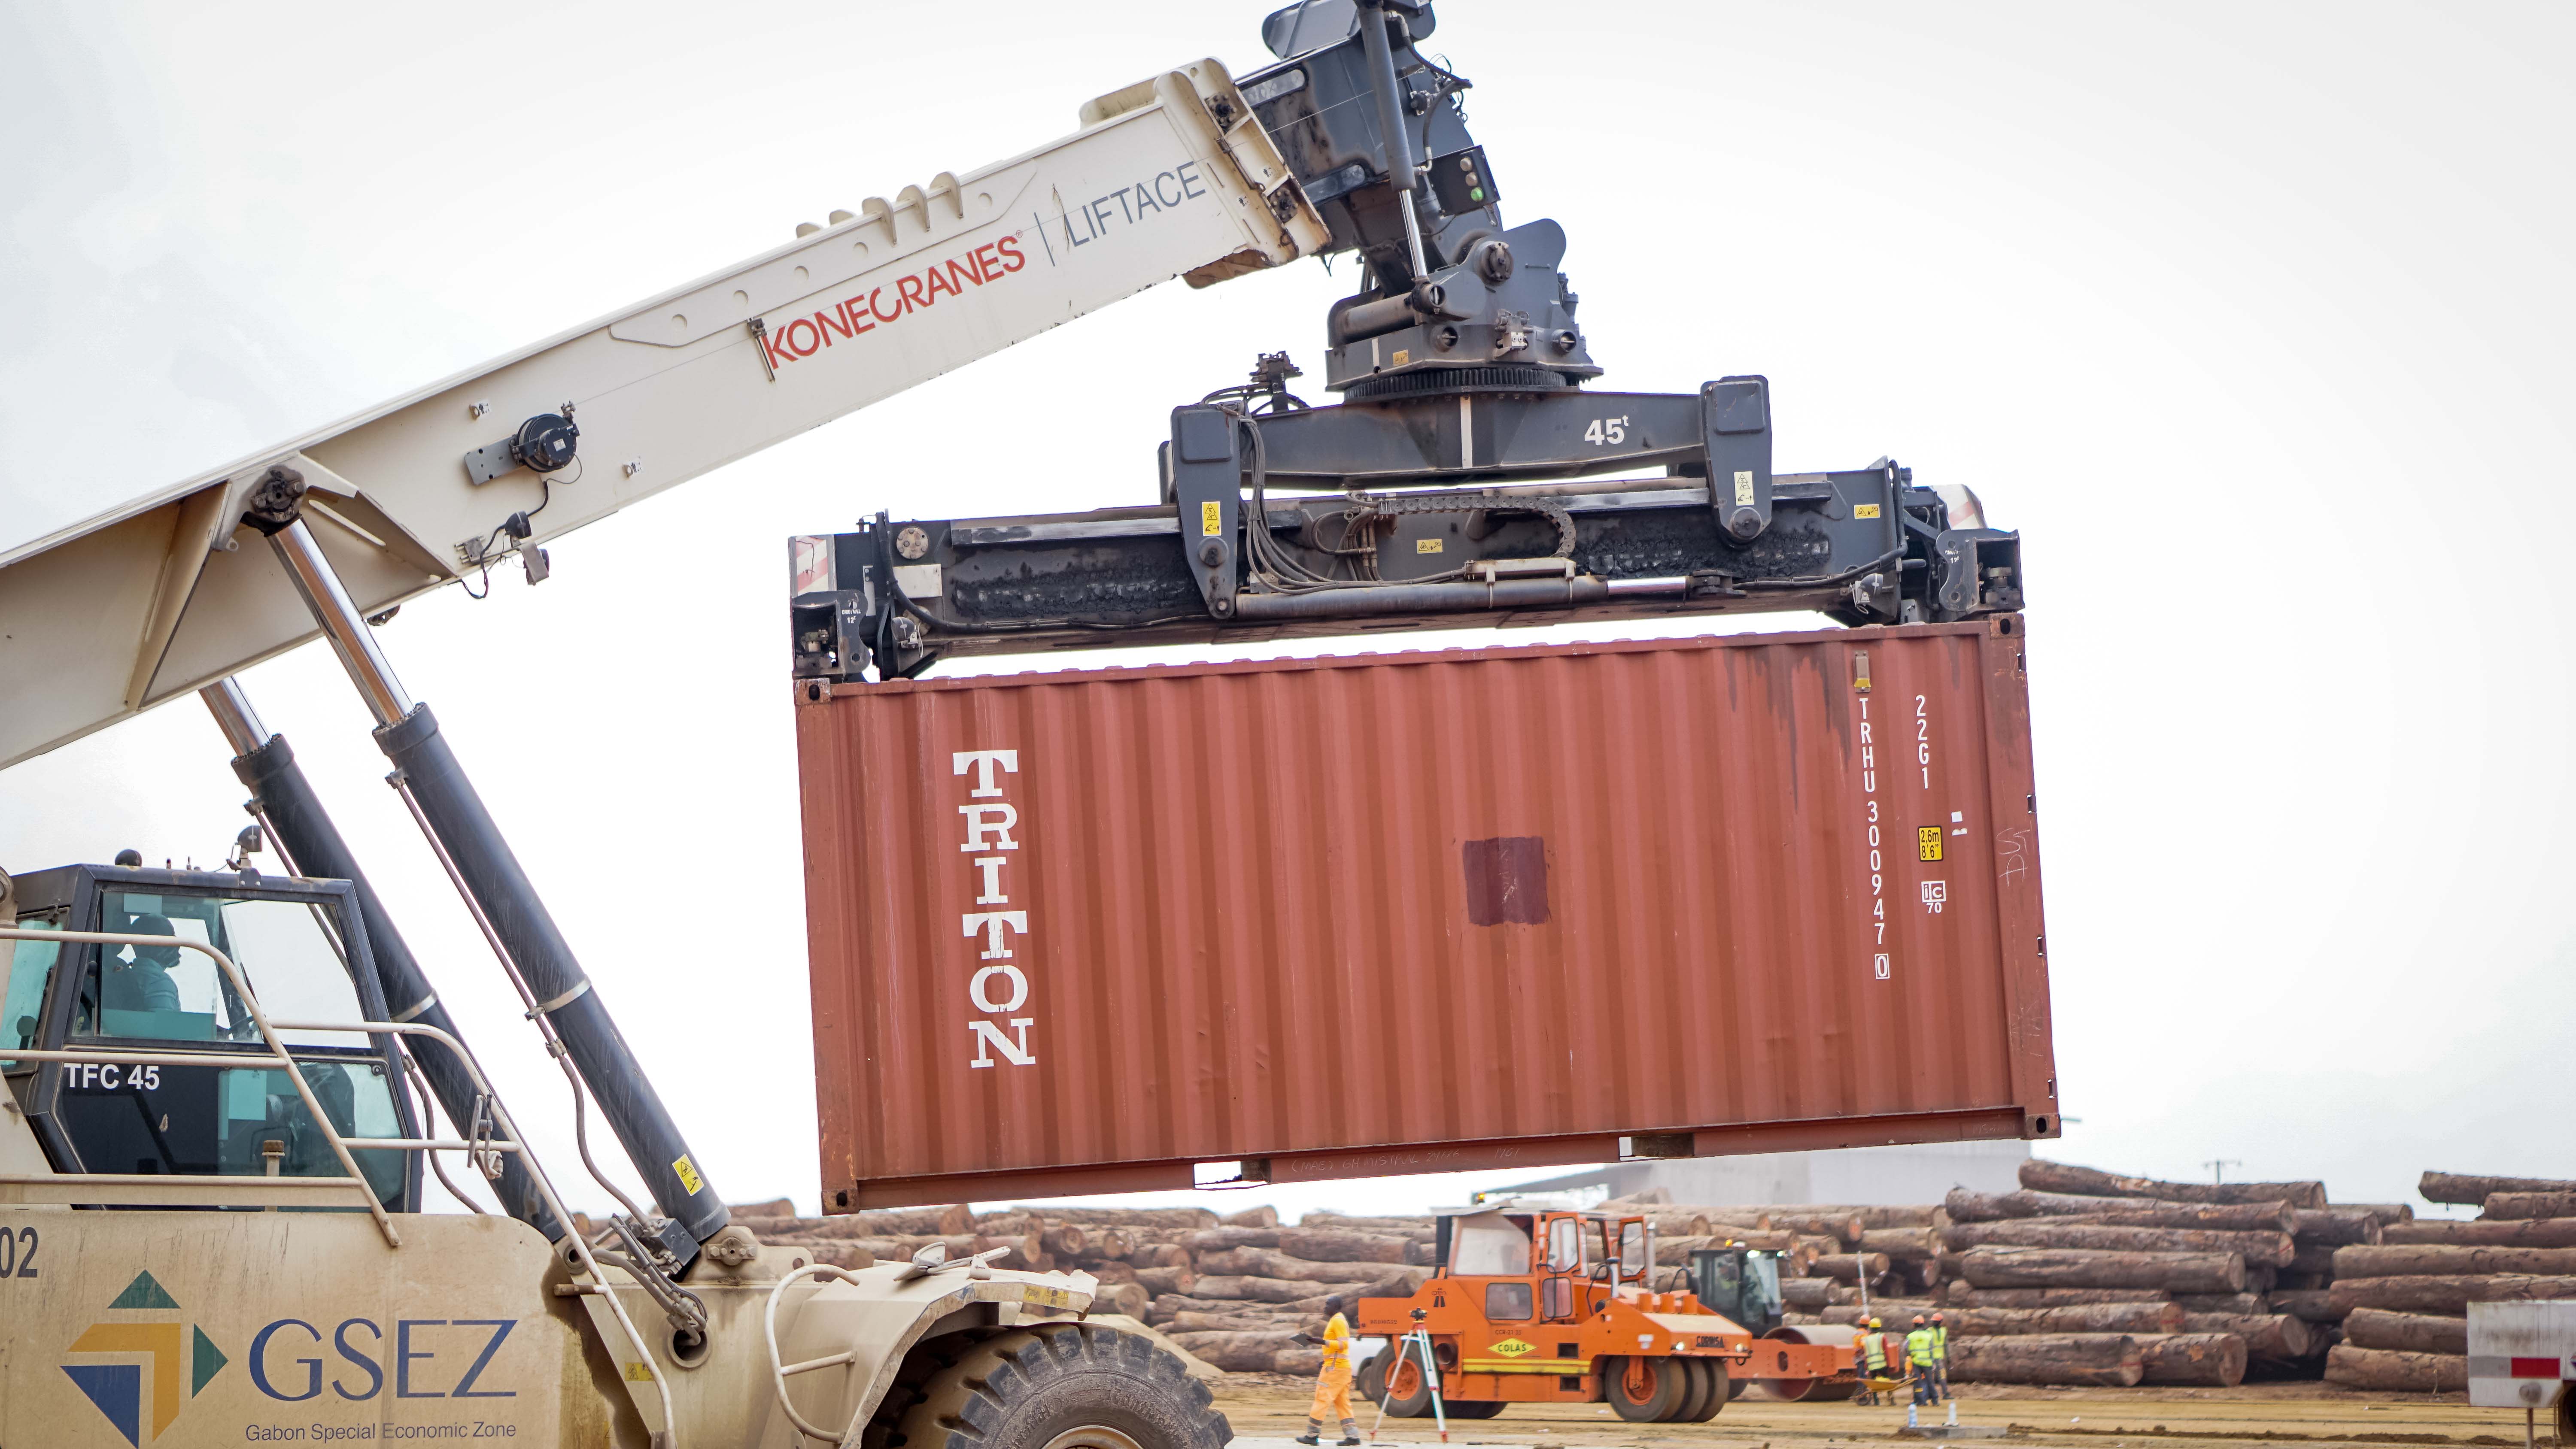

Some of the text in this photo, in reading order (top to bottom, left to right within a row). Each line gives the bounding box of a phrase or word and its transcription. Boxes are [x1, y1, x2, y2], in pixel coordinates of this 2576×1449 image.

[1064, 161, 1206, 247] LIFTACE
[1915, 695, 1929, 789] 22G1
[1859, 697, 1875, 792] TRHU
[1867, 801, 1885, 945] 300947
[1920, 829, 1939, 844] 2,6m
[953, 749, 1036, 1068] TRITON
[1926, 902, 1942, 914] 70
[64, 1063, 160, 1090] TFC 45
[249, 1318, 519, 1401] GSEZ
[1498, 1344, 1527, 1352] COLAS
[246, 1421, 516, 1443] Gabon Special Economic Zone
